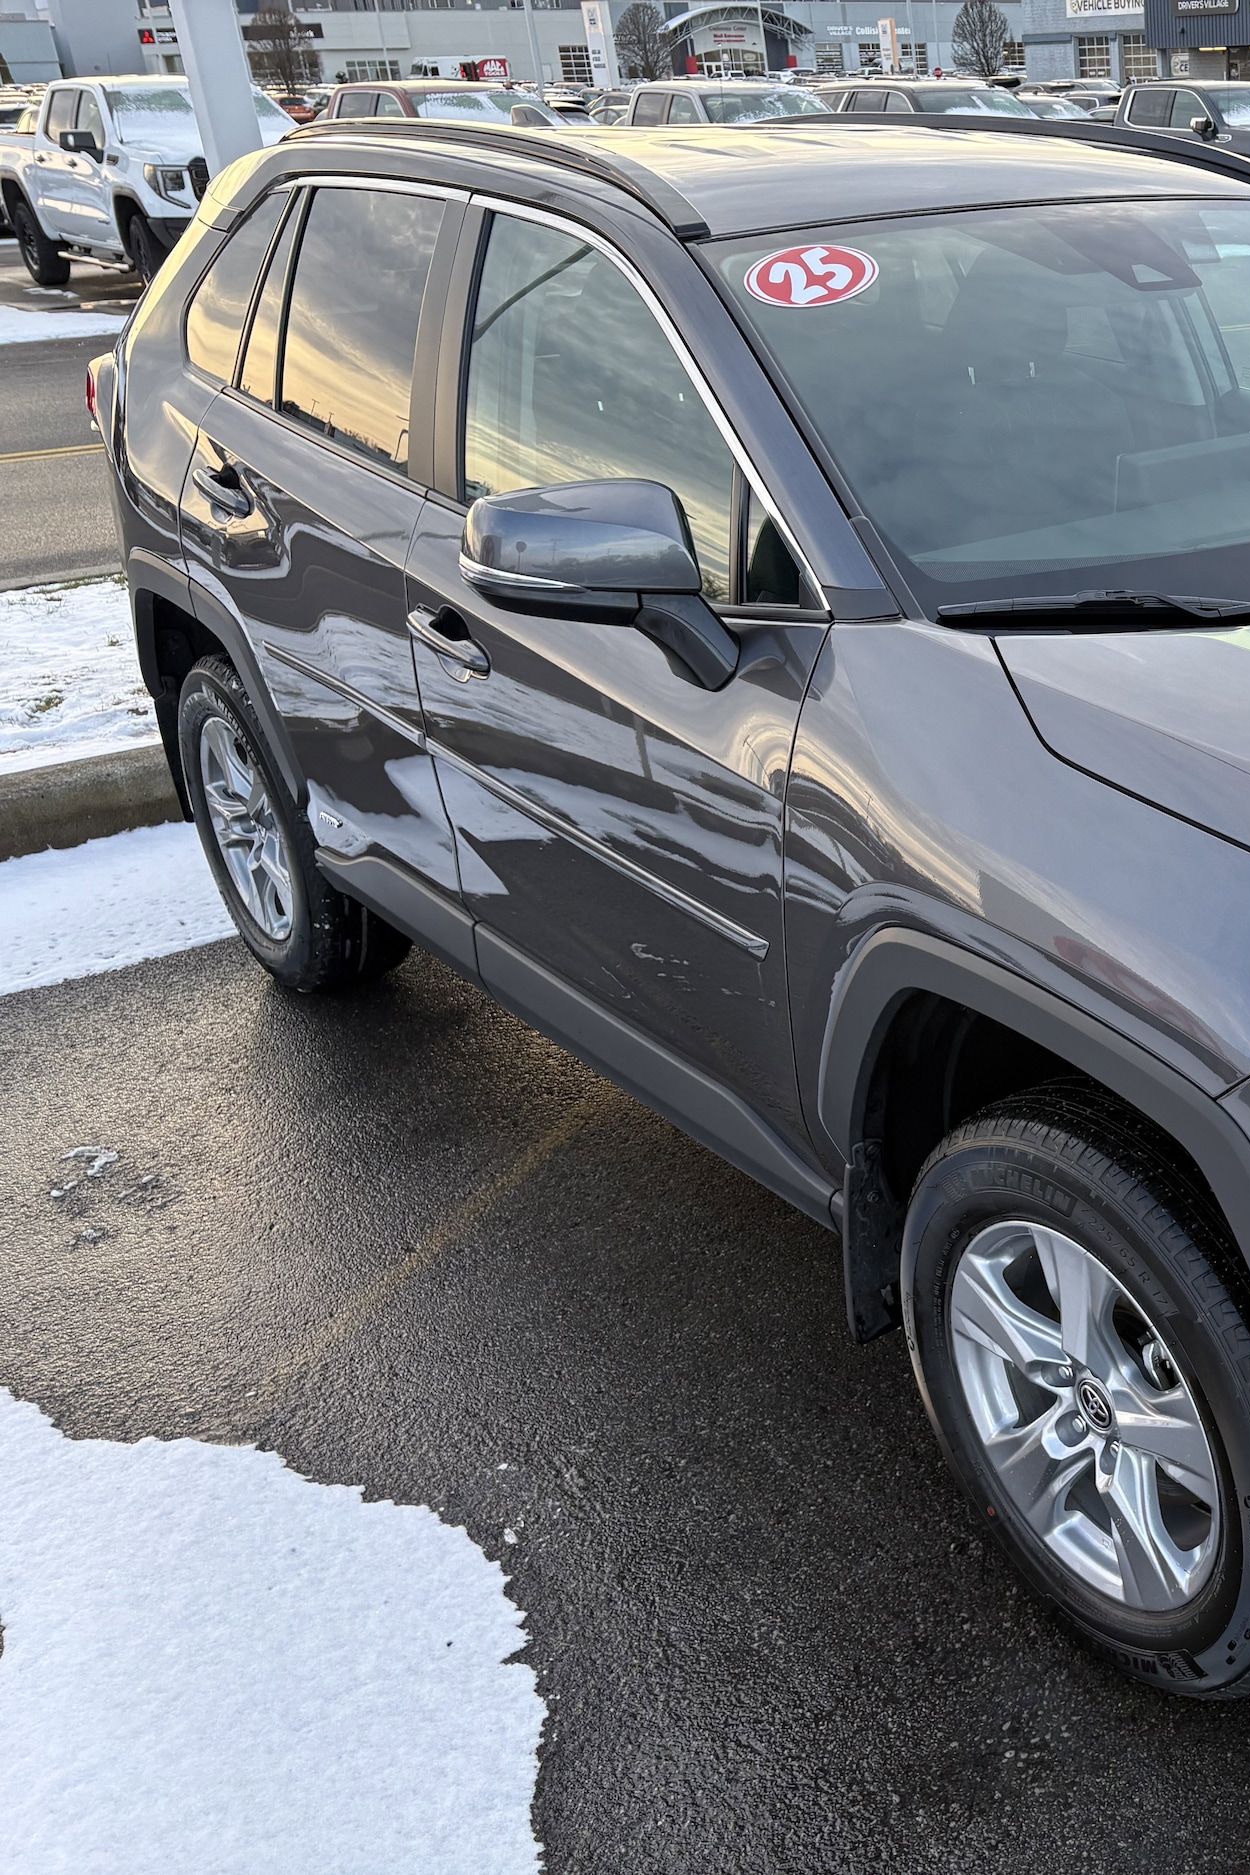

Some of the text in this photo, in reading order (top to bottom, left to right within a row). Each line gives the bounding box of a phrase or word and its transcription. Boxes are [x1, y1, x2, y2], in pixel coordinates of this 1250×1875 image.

[1078, 0, 1112, 11] VEHICLE
[1203, 0, 1229, 8] VILLAGE
[855, 26, 911, 35] Collisi enter
[769, 247, 853, 305] 25
[971, 1166, 1073, 1214] MICHELIN
